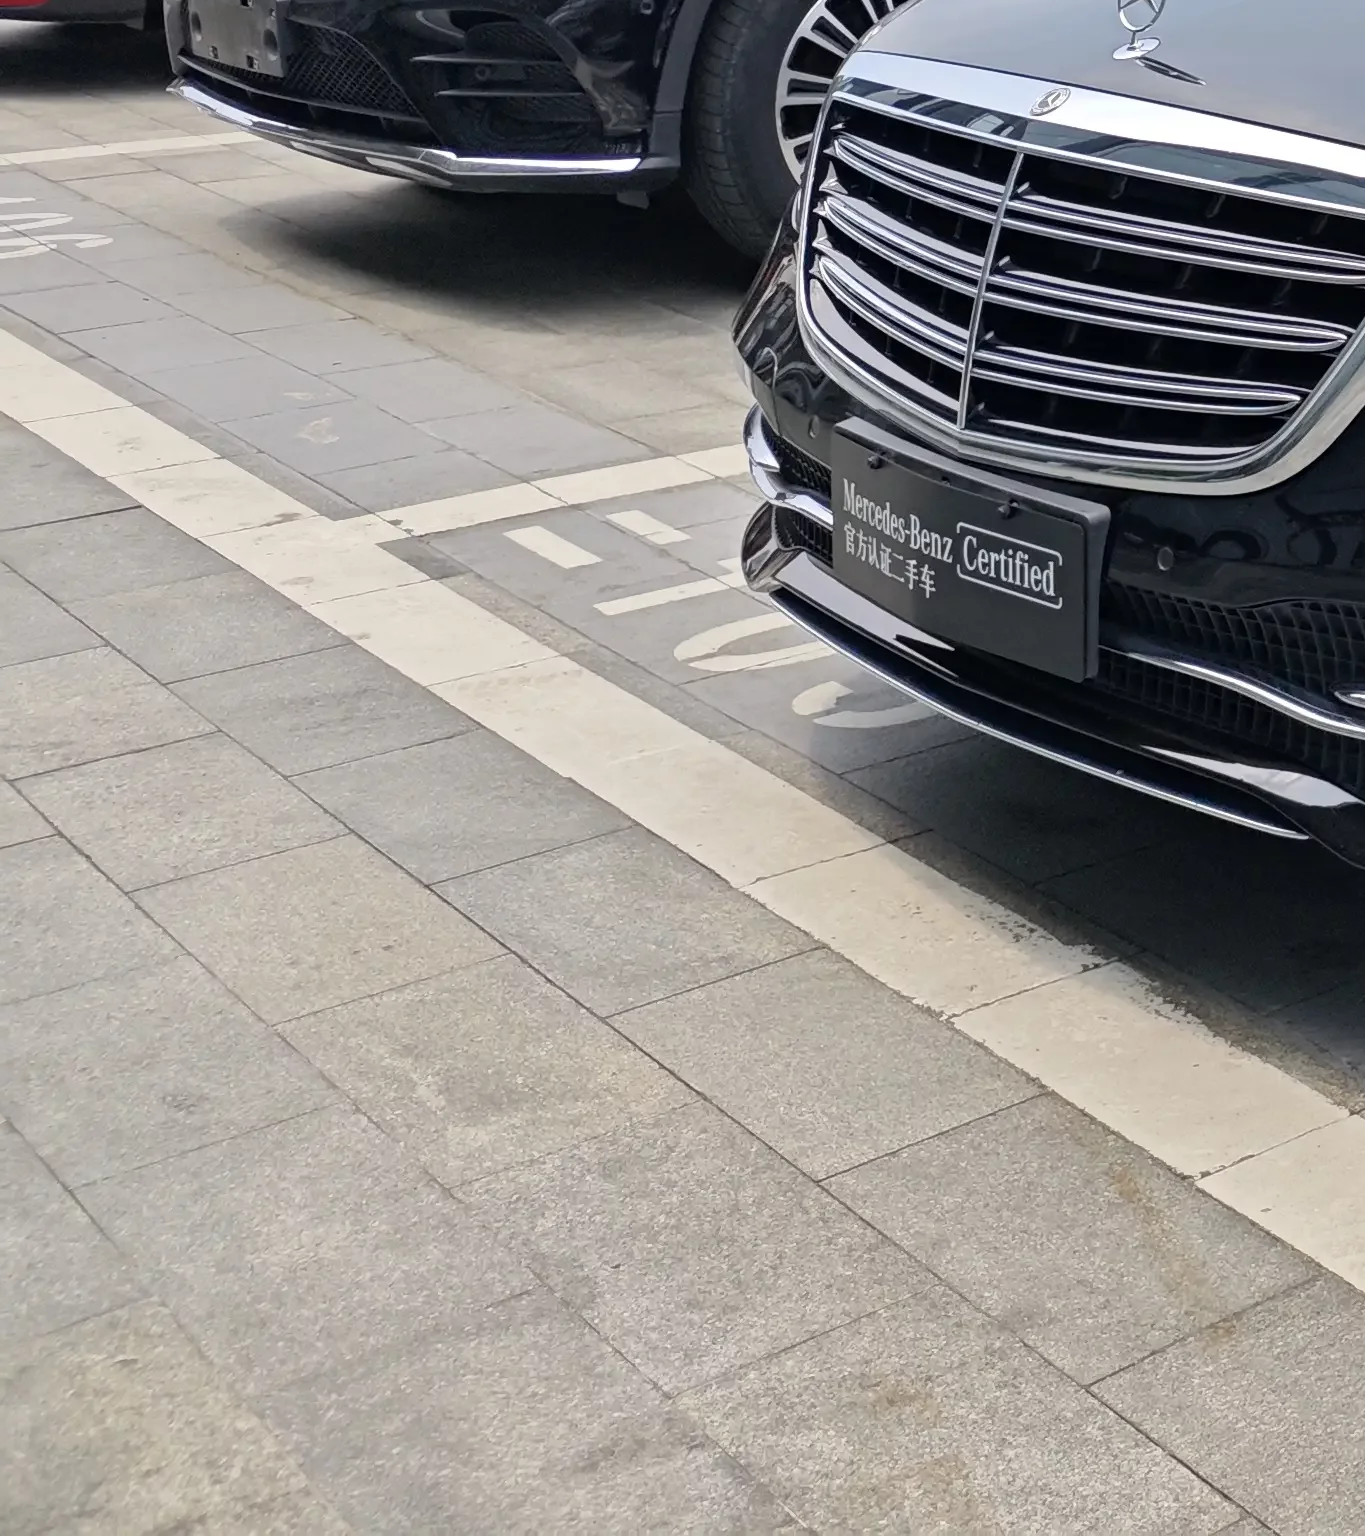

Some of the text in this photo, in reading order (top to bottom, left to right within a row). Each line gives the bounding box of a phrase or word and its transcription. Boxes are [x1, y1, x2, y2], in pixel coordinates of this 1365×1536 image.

[842, 478, 1056, 597] Mercedes-Benz Certified
[843, 521, 937, 599] 官方认证二手车
